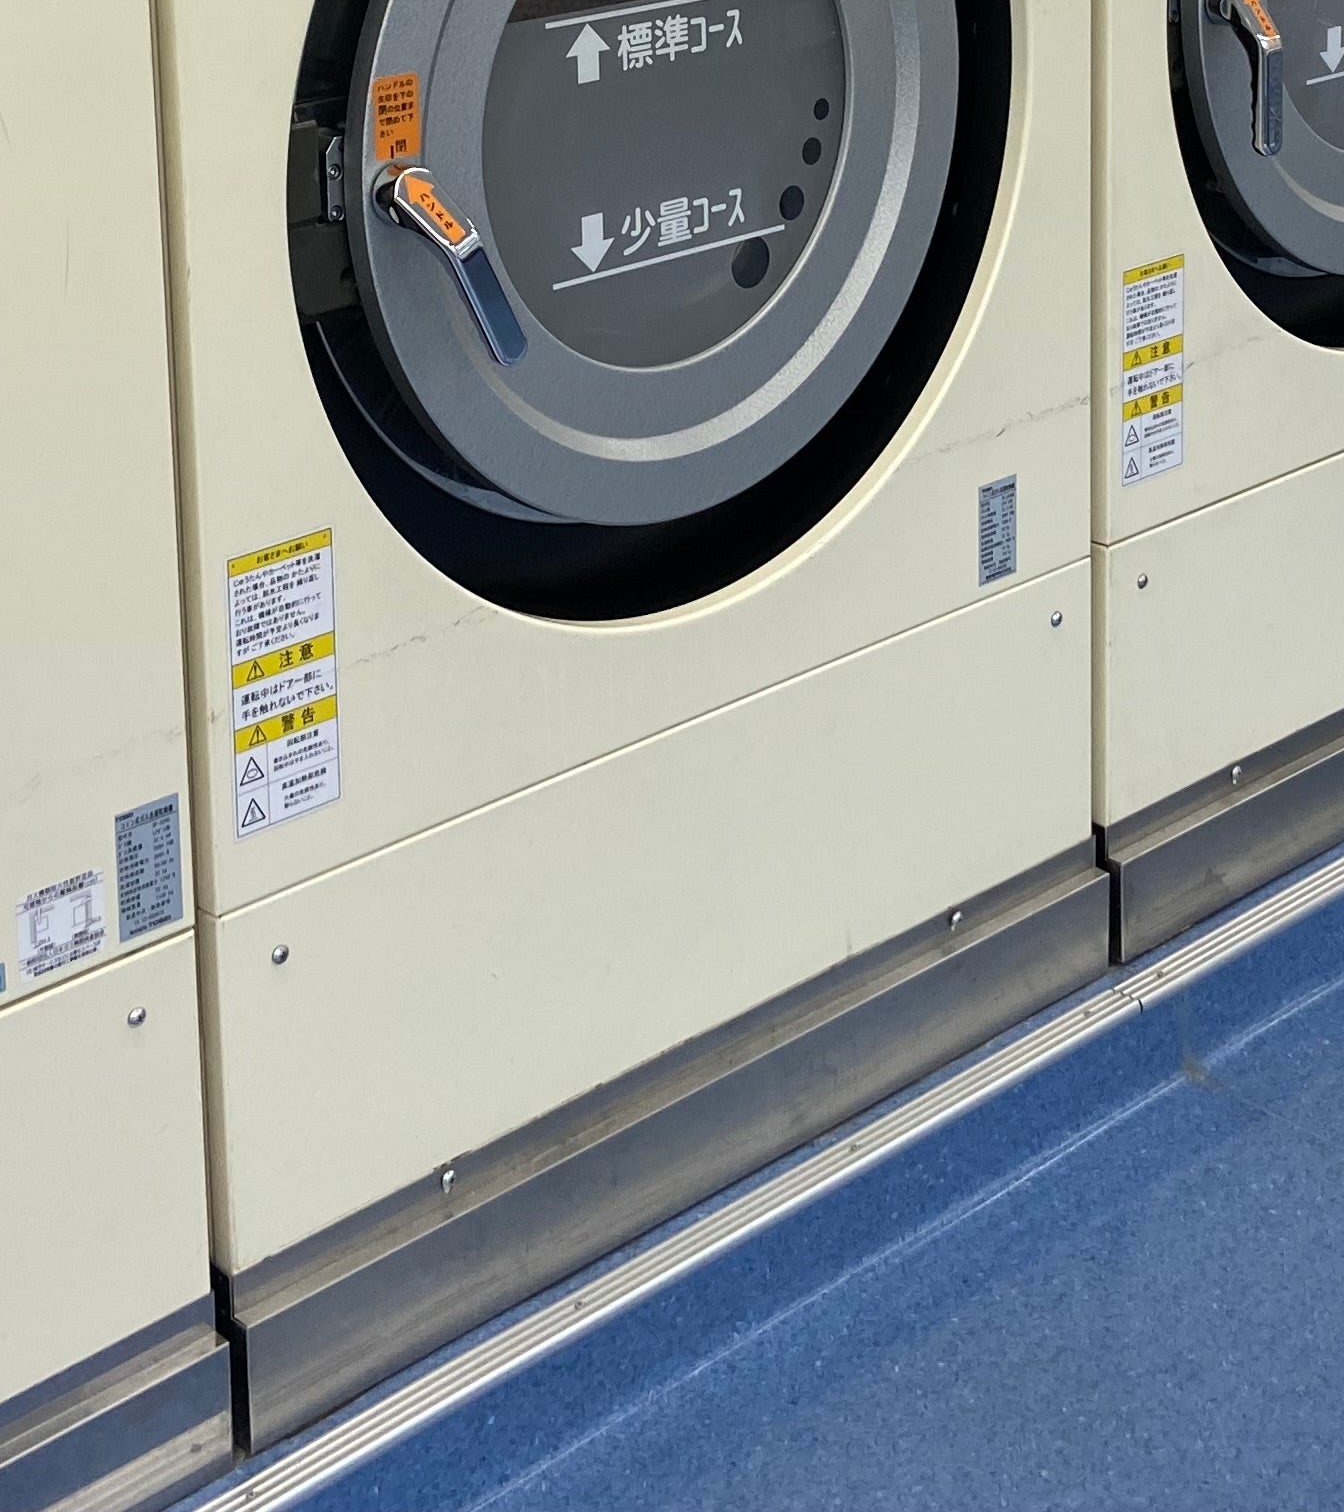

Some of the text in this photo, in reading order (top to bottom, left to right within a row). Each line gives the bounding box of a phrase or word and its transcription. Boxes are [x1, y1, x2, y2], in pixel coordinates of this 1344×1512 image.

[615, 8, 744, 72] 標準コース
[619, 188, 746, 259] 少量コース
[279, 644, 314, 669] 注意
[281, 707, 315, 734] 警告
